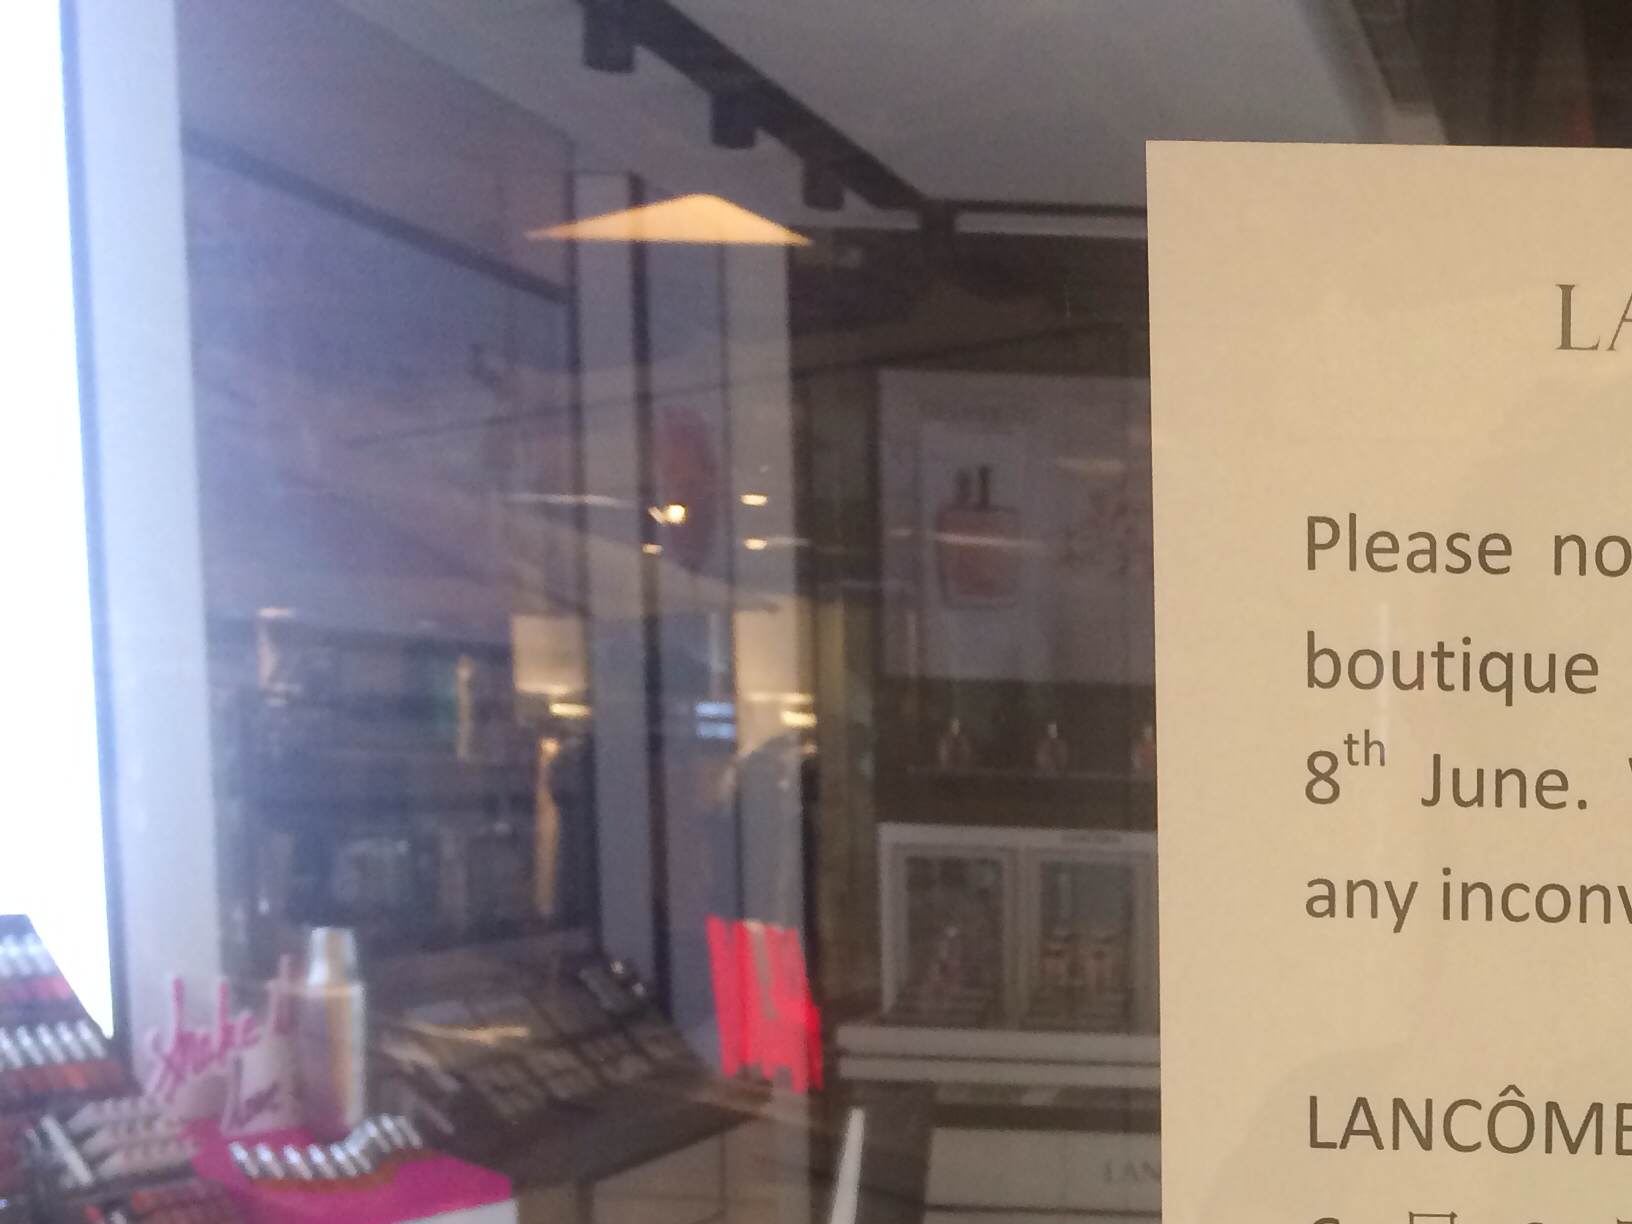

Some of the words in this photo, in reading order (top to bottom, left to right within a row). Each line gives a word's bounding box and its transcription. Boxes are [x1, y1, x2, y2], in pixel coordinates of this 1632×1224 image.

[1306, 511, 1513, 576] Please
[1306, 630, 1599, 708] boutique
[1304, 728, 1386, 805] 8th
[1420, 753, 1588, 811] June.
[1305, 877, 1419, 934] any
